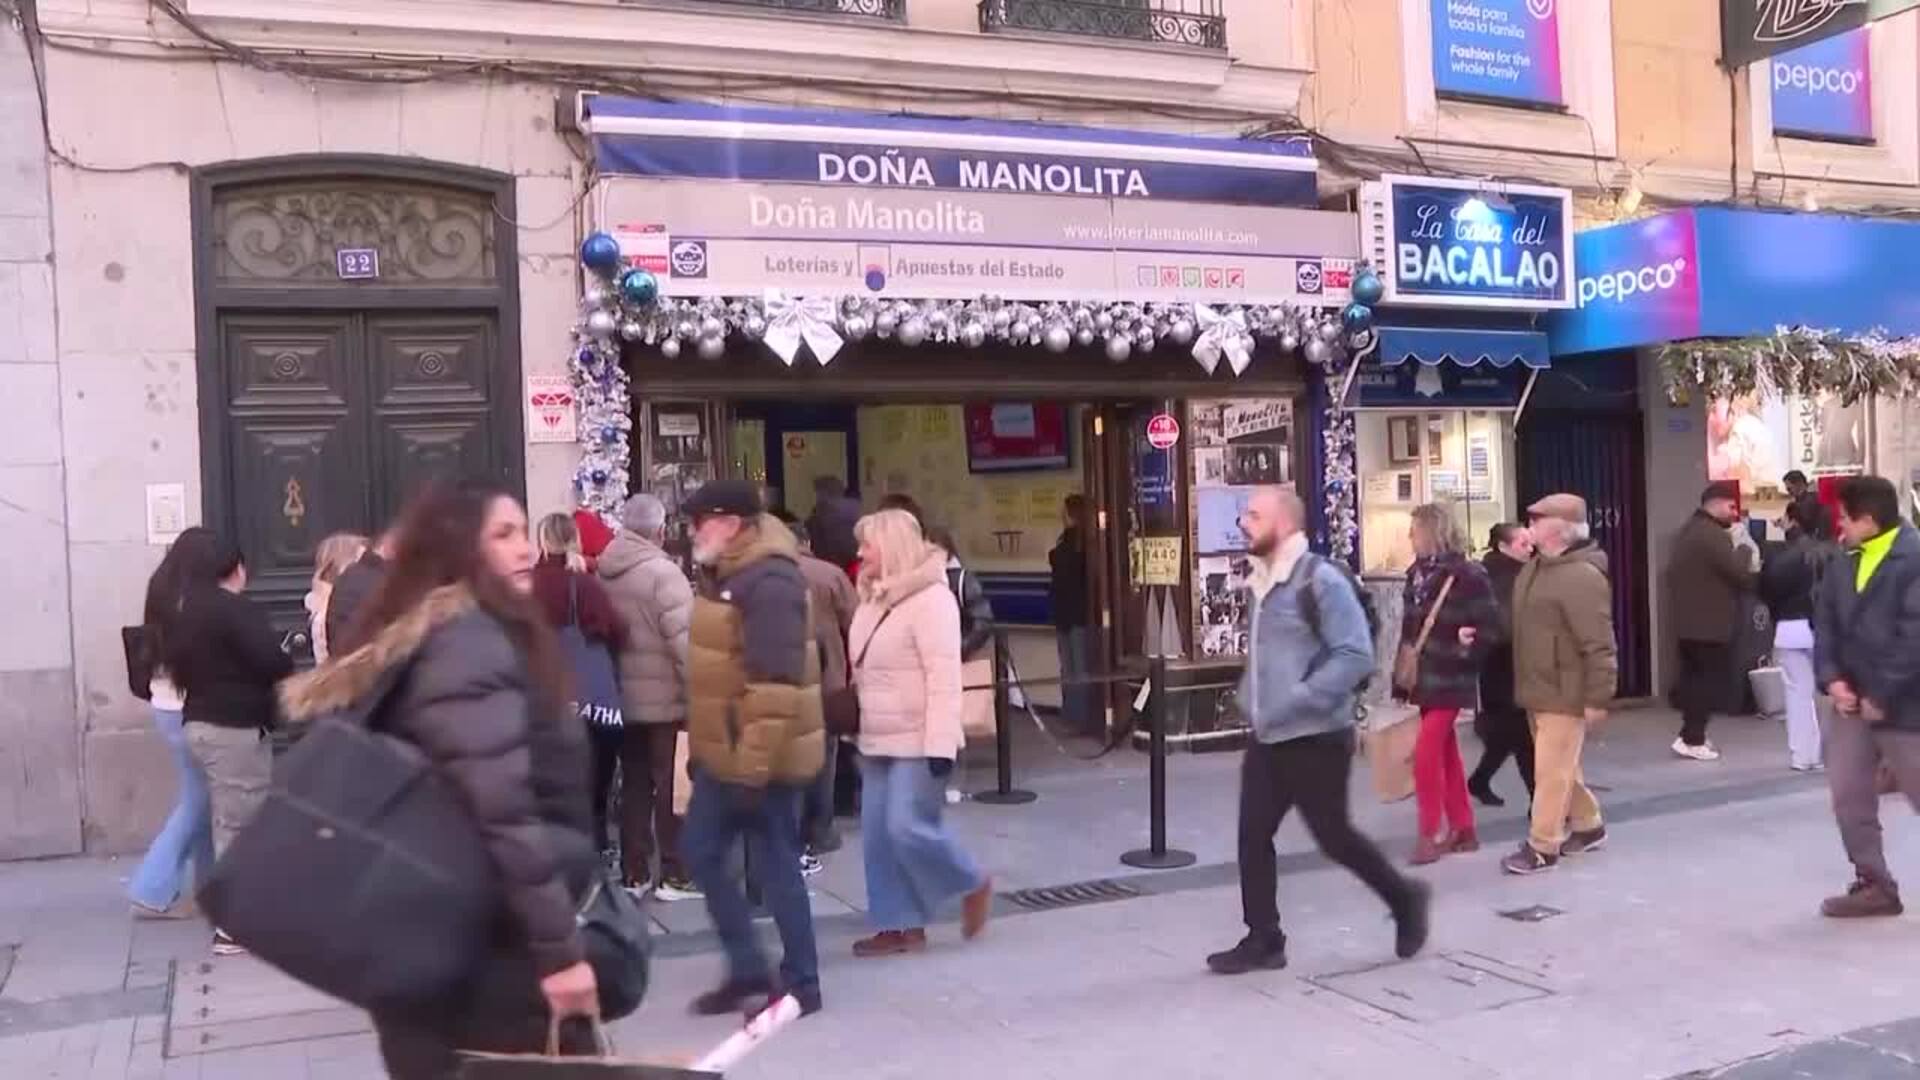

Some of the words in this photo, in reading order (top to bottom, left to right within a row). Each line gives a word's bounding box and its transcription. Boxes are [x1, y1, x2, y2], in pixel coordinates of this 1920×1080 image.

[1448, 2, 1480, 16] Moda
[1482, 8, 1508, 22] para
[1449, 18, 1475, 31] toda
[1477, 20, 1488, 33] la
[1490, 22, 1525, 39] familia
[1450, 44, 1495, 62] Fashion
[1497, 50, 1510, 64] for
[1512, 51, 1531, 67] the
[1452, 61, 1485, 75] whole
[1487, 65, 1520, 83] family
[1774, 61, 1857, 95] pepco
[818, 149, 935, 186] DOÑA
[959, 160, 1149, 196] MANOLITA
[751, 195, 836, 230] Doña
[847, 199, 985, 235] Manolita
[1411, 204, 1444, 239] La
[1513, 215, 1546, 245] del
[345, 254, 370, 272] 22
[844, 259, 854, 277] y
[896, 259, 974, 278] Apuestas
[980, 260, 1004, 277] del
[1009, 261, 1064, 279] Estado
[1399, 243, 1559, 288] BACALAO
[1578, 263, 1677, 308] pepco
